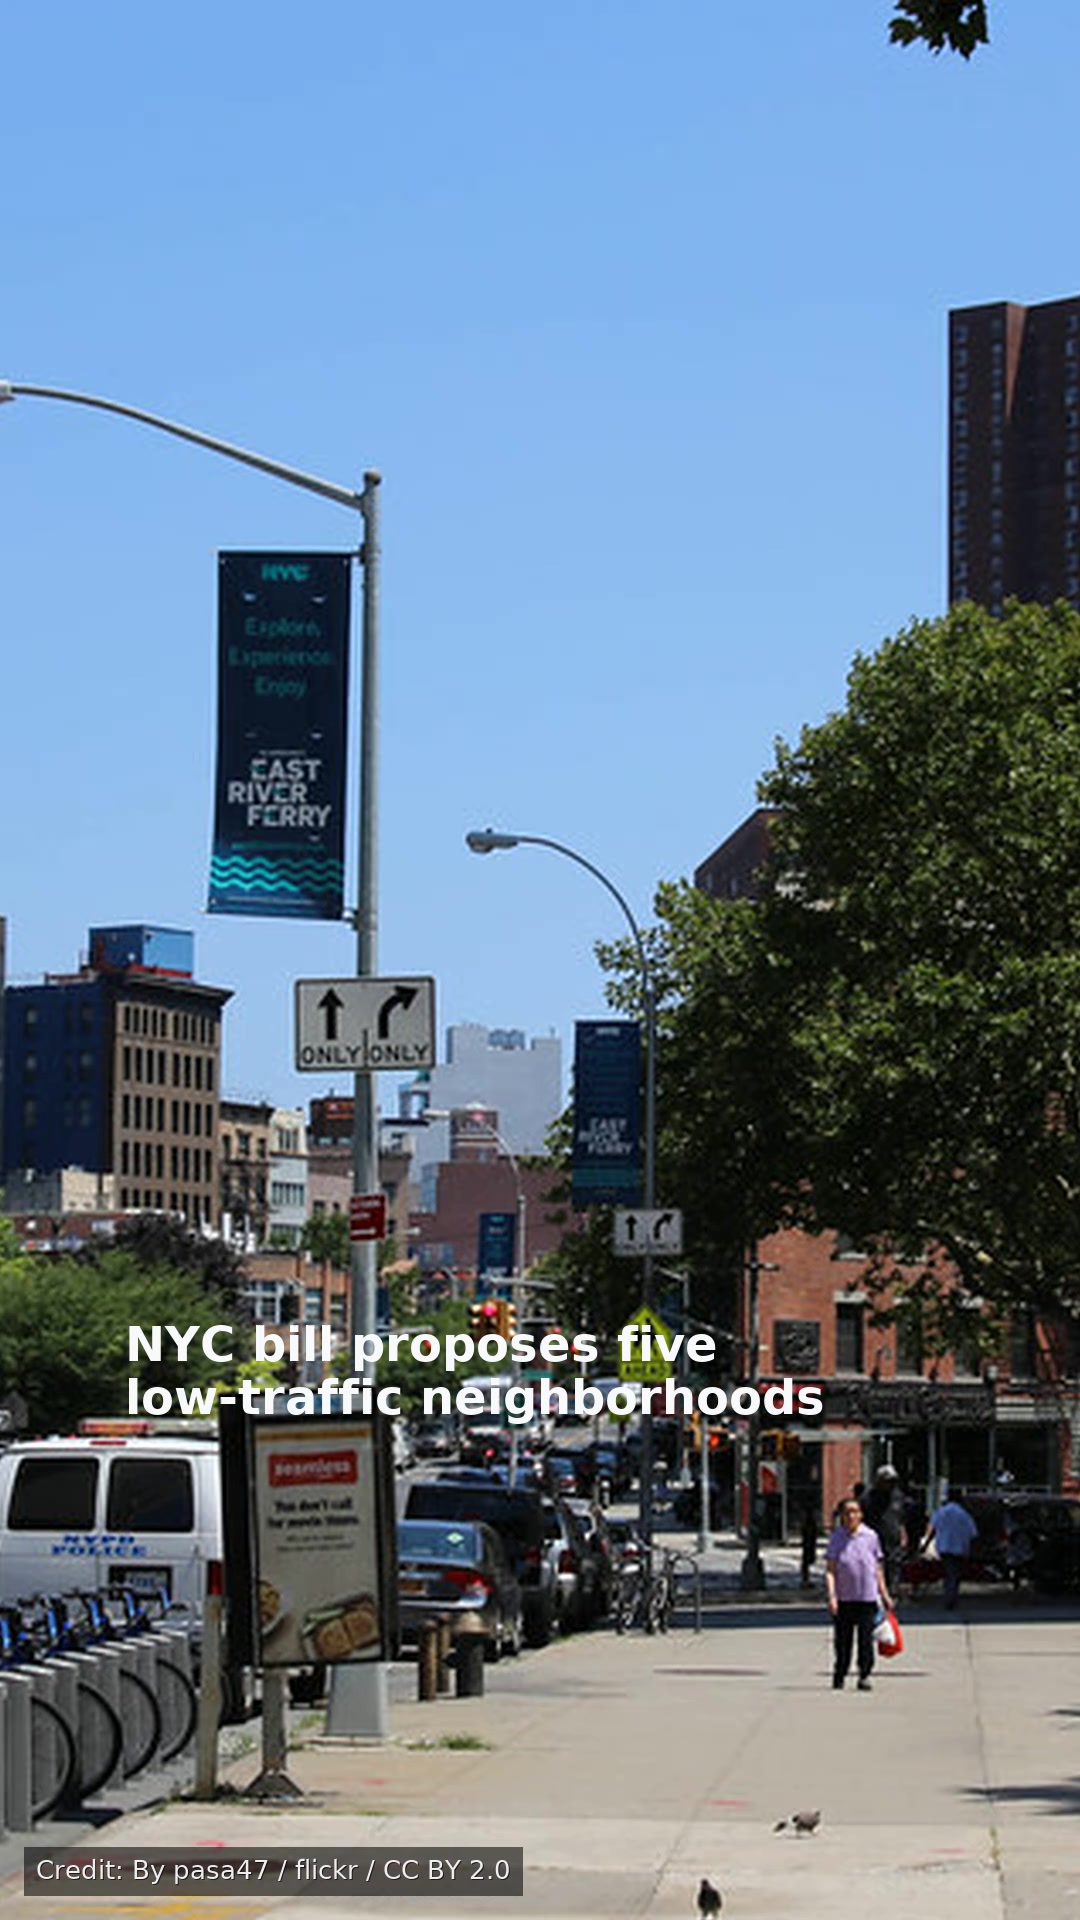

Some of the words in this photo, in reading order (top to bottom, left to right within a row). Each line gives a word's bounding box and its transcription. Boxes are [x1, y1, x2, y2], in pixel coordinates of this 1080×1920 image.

[260, 563, 312, 581] NYC
[251, 758, 323, 781] EAST
[227, 781, 308, 803] RIVER
[247, 803, 332, 828] FERRY
[302, 1045, 361, 1065] ONLY
[370, 1043, 430, 1063] ONLY
[64, 1534, 135, 1544] NYPD
[52, 1545, 147, 1556] POLICE
